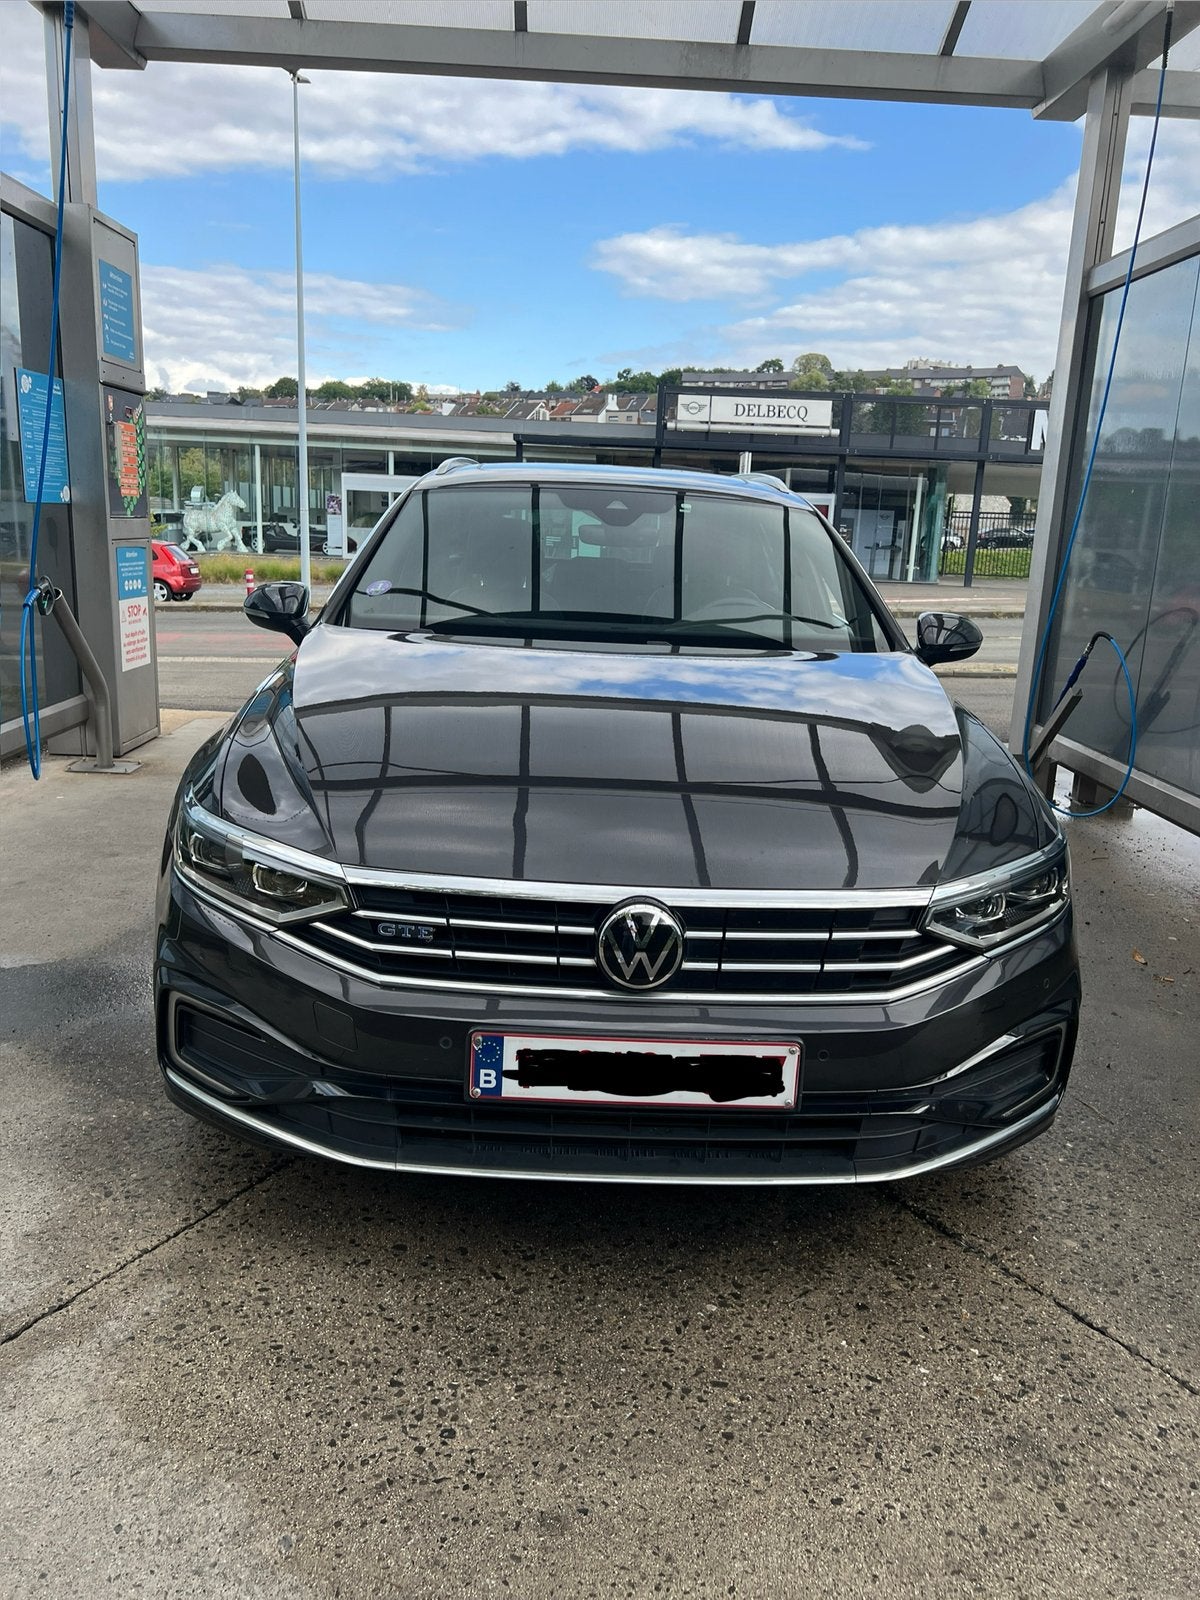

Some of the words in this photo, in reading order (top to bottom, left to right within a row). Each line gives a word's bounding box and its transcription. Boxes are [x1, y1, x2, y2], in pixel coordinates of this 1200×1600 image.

[734, 403, 808, 422] DELBECQ
[127, 604, 141, 617] STOP
[377, 922, 434, 939] GTE
[479, 1068, 497, 1088] B
